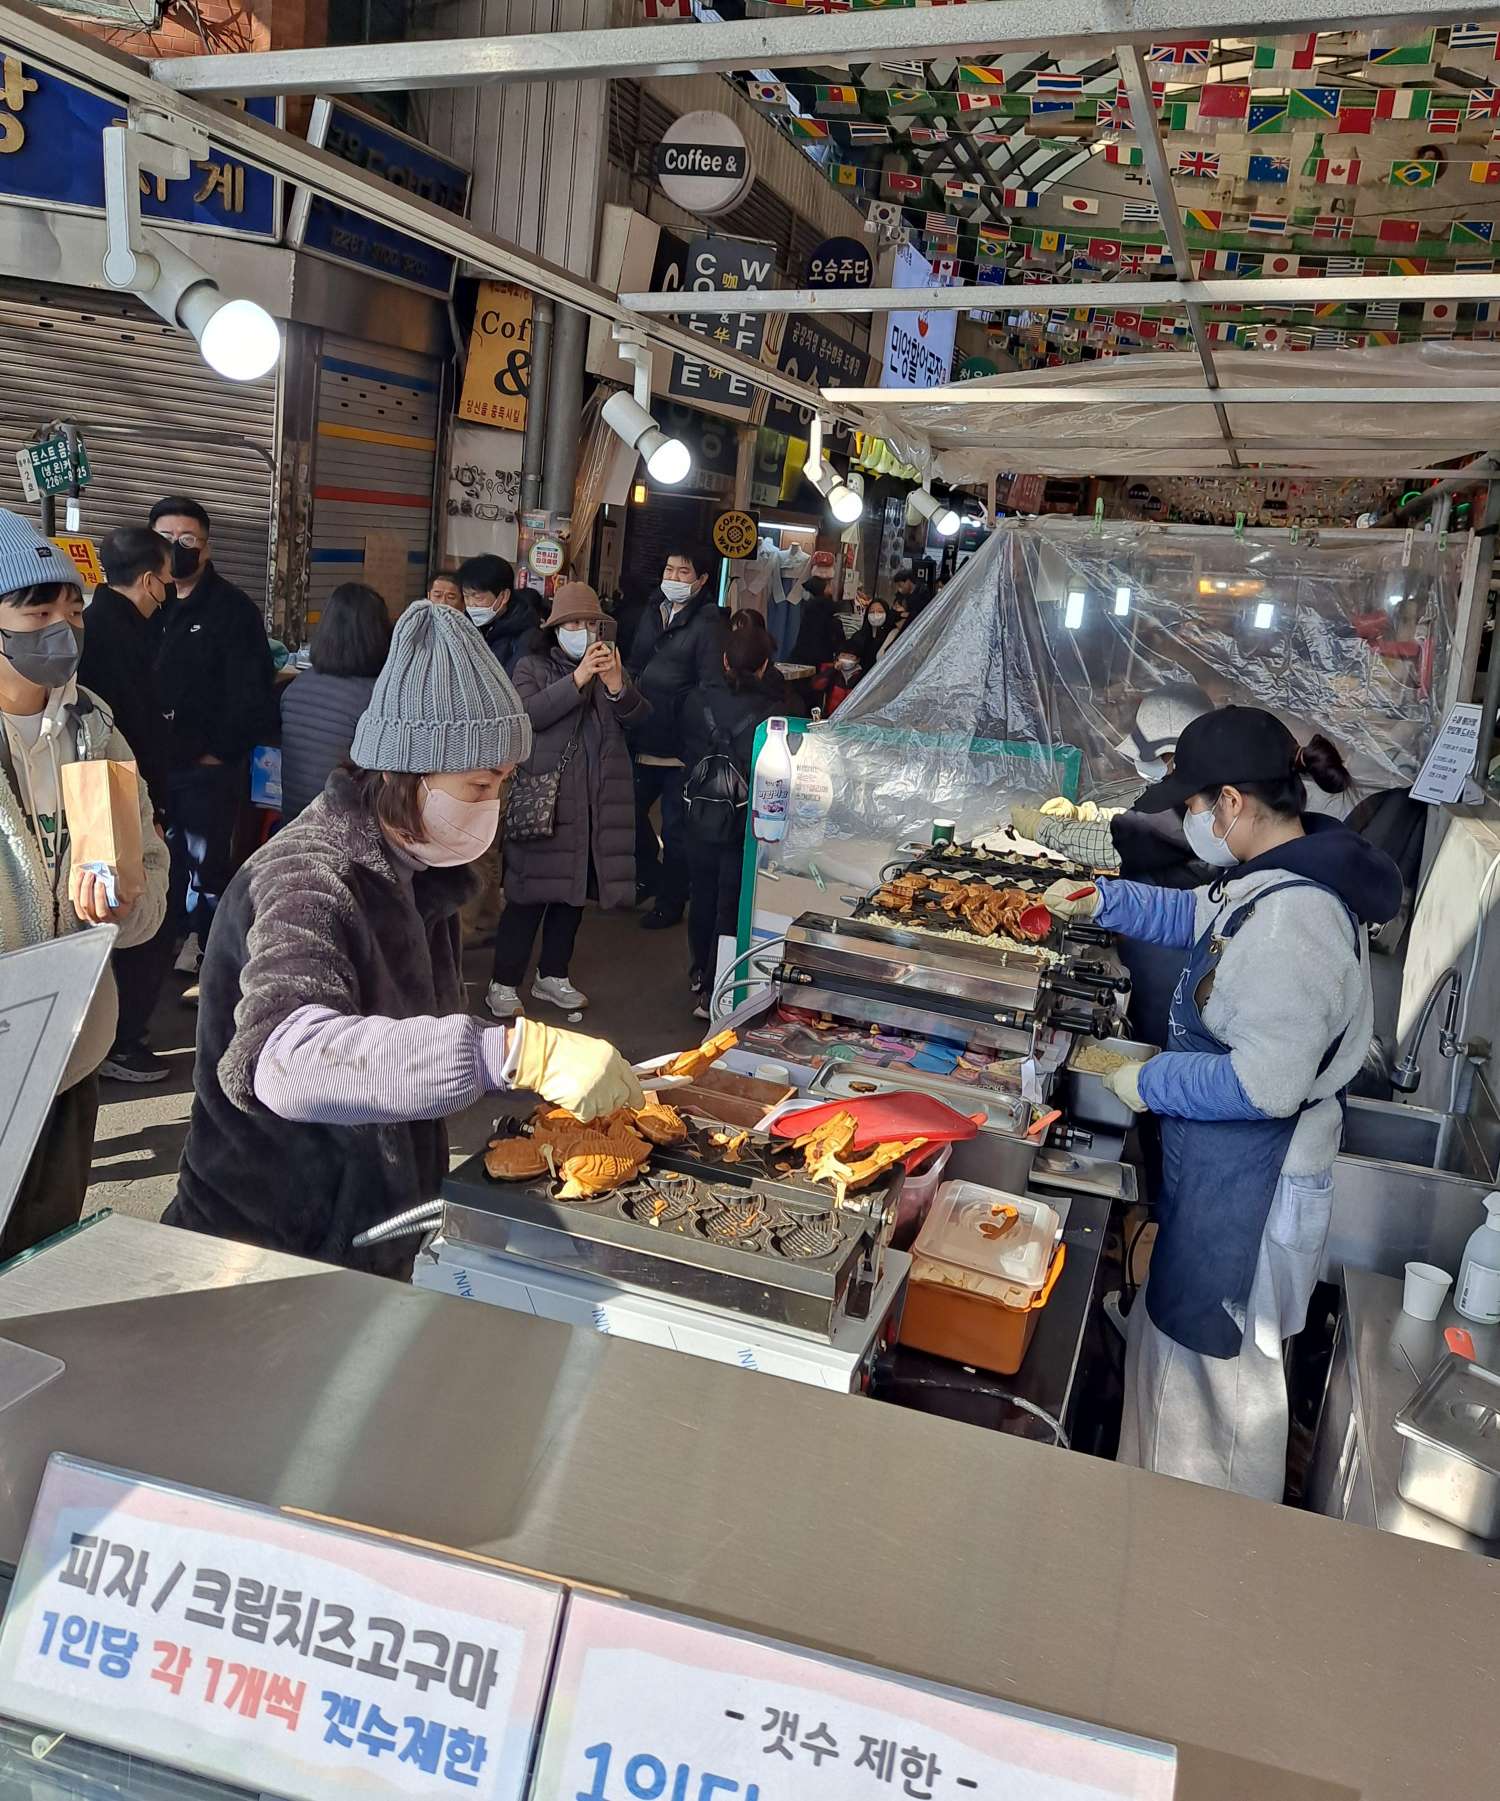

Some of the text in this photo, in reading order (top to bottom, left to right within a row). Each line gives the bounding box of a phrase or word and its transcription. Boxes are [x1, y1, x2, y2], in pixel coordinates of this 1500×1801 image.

[665, 148, 737, 172] Coffee &
[808, 258, 869, 284] 오승주단
[494, 349, 533, 397] &
[466, 400, 488, 416] 당신을
[31, 446, 58, 466] 토스트
[718, 515, 753, 533] COFFEE
[717, 536, 752, 554] WAFFLE
[39, 1611, 487, 1787] 1인당 각 1개씩 갯수제한
[761, 1707, 839, 1766] 갯수
[854, 1735, 942, 1801] 제한
